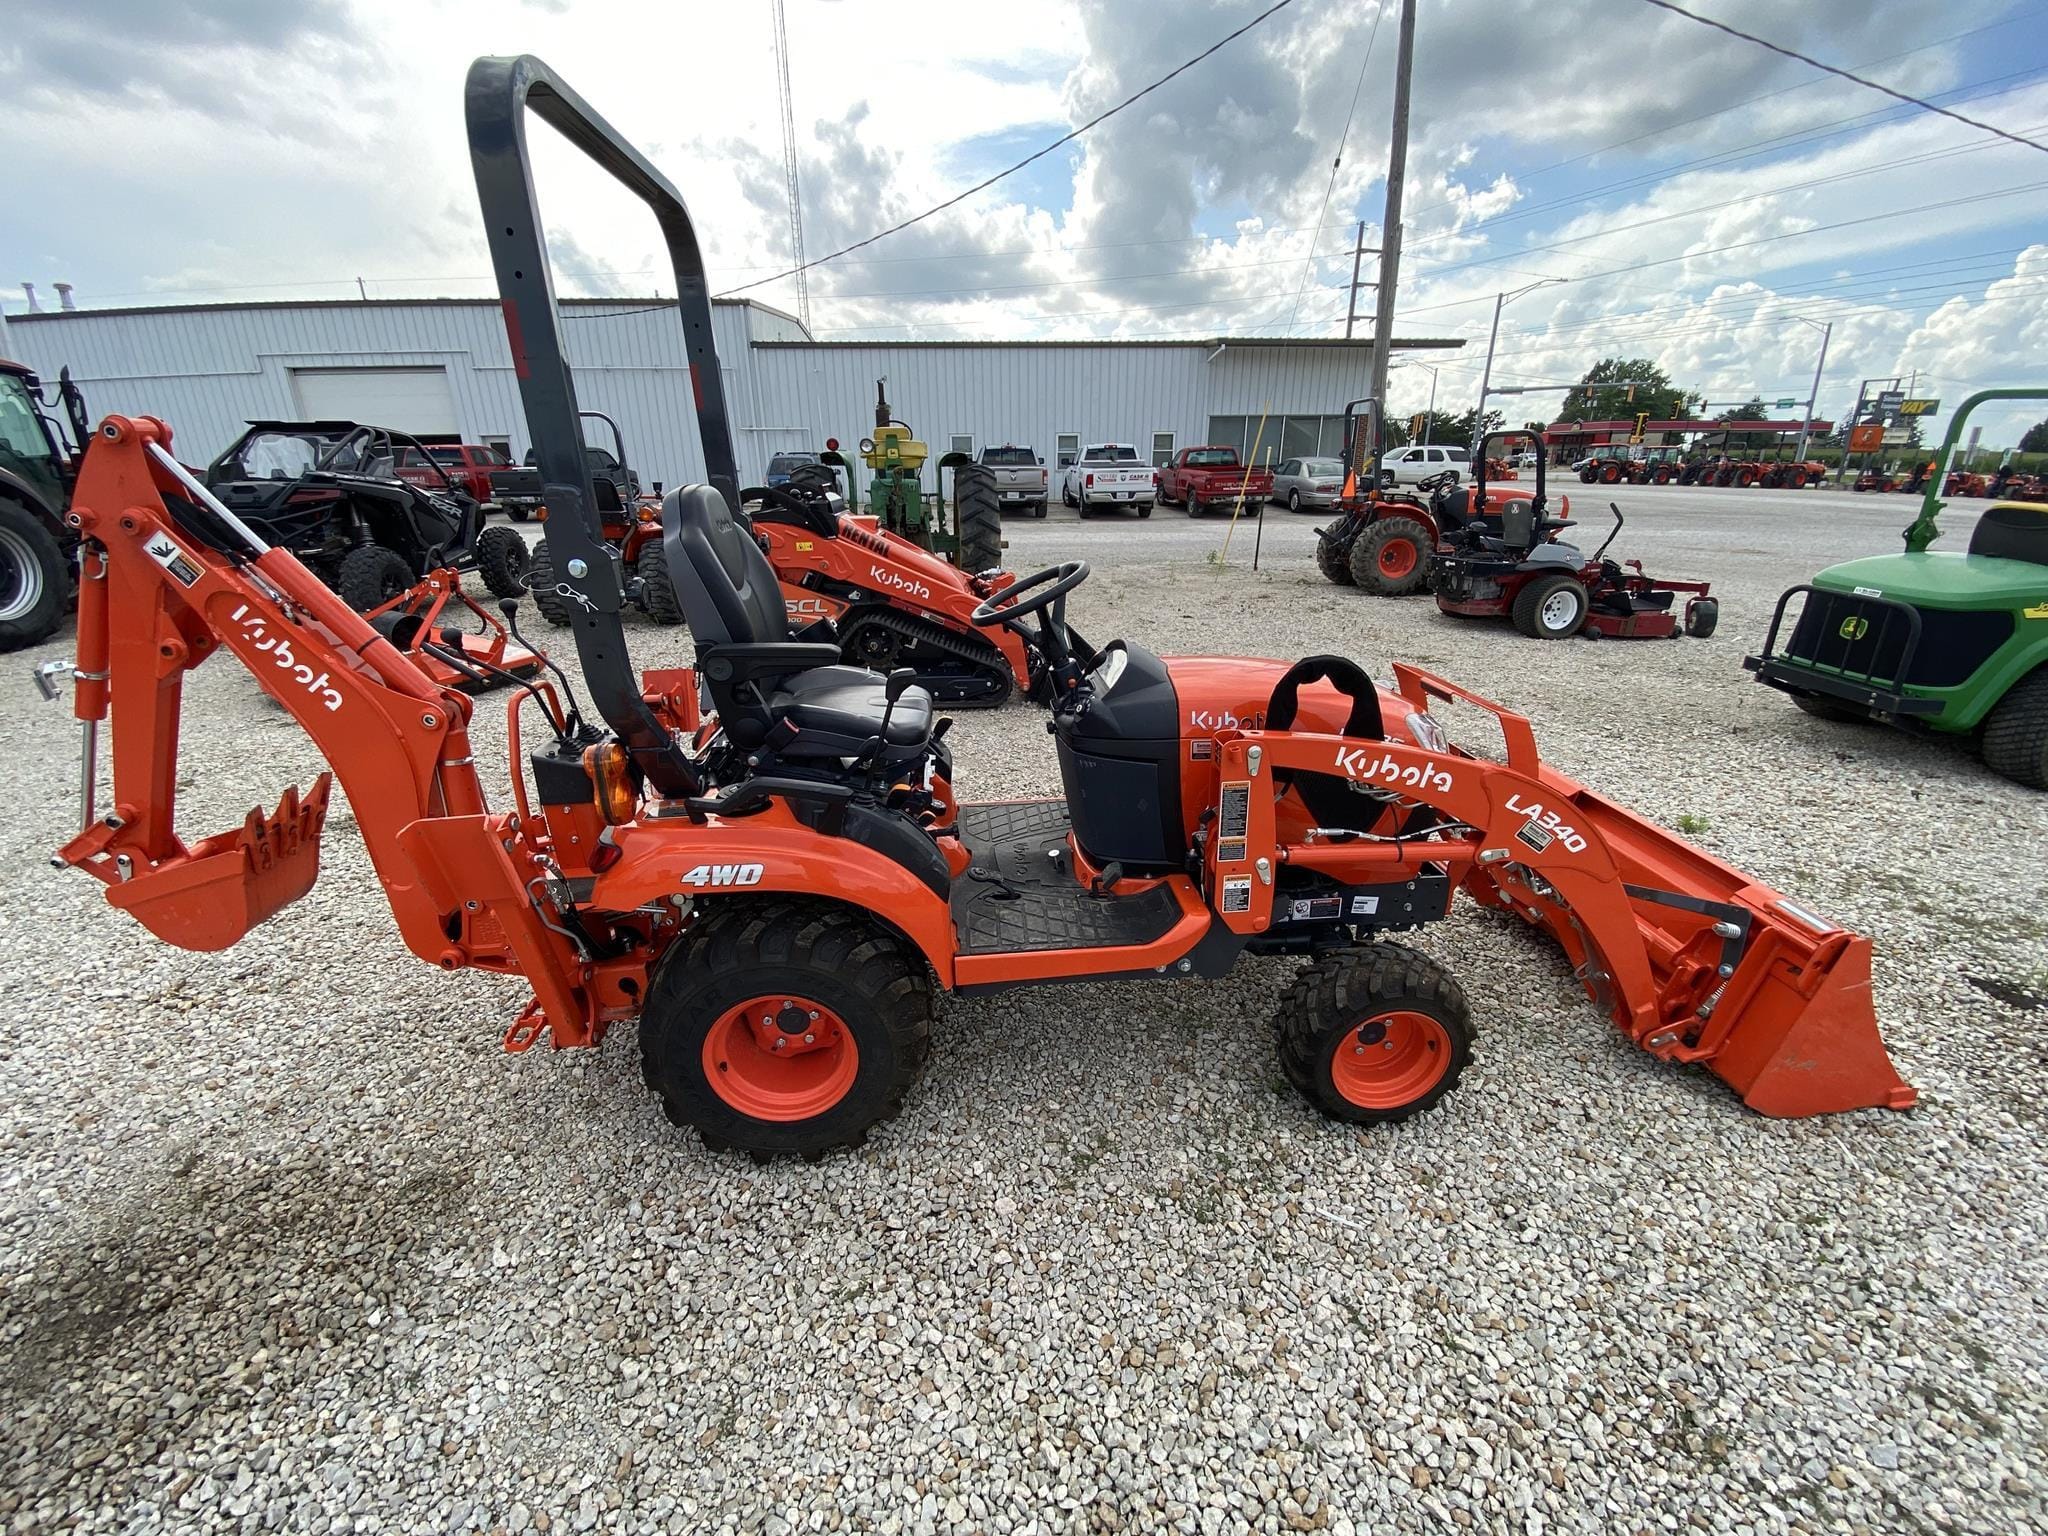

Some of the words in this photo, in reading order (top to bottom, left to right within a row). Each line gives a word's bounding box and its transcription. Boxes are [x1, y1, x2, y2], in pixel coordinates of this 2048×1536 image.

[429, 495, 462, 517] RZR
[841, 525, 890, 558] RENTAL
[870, 565, 930, 600] Kubota
[785, 600, 828, 613] SCL
[231, 604, 343, 712] Kubota
[1334, 746, 1454, 793] Kubota
[1504, 793, 1588, 853] LA340
[680, 863, 765, 887] 4WD
